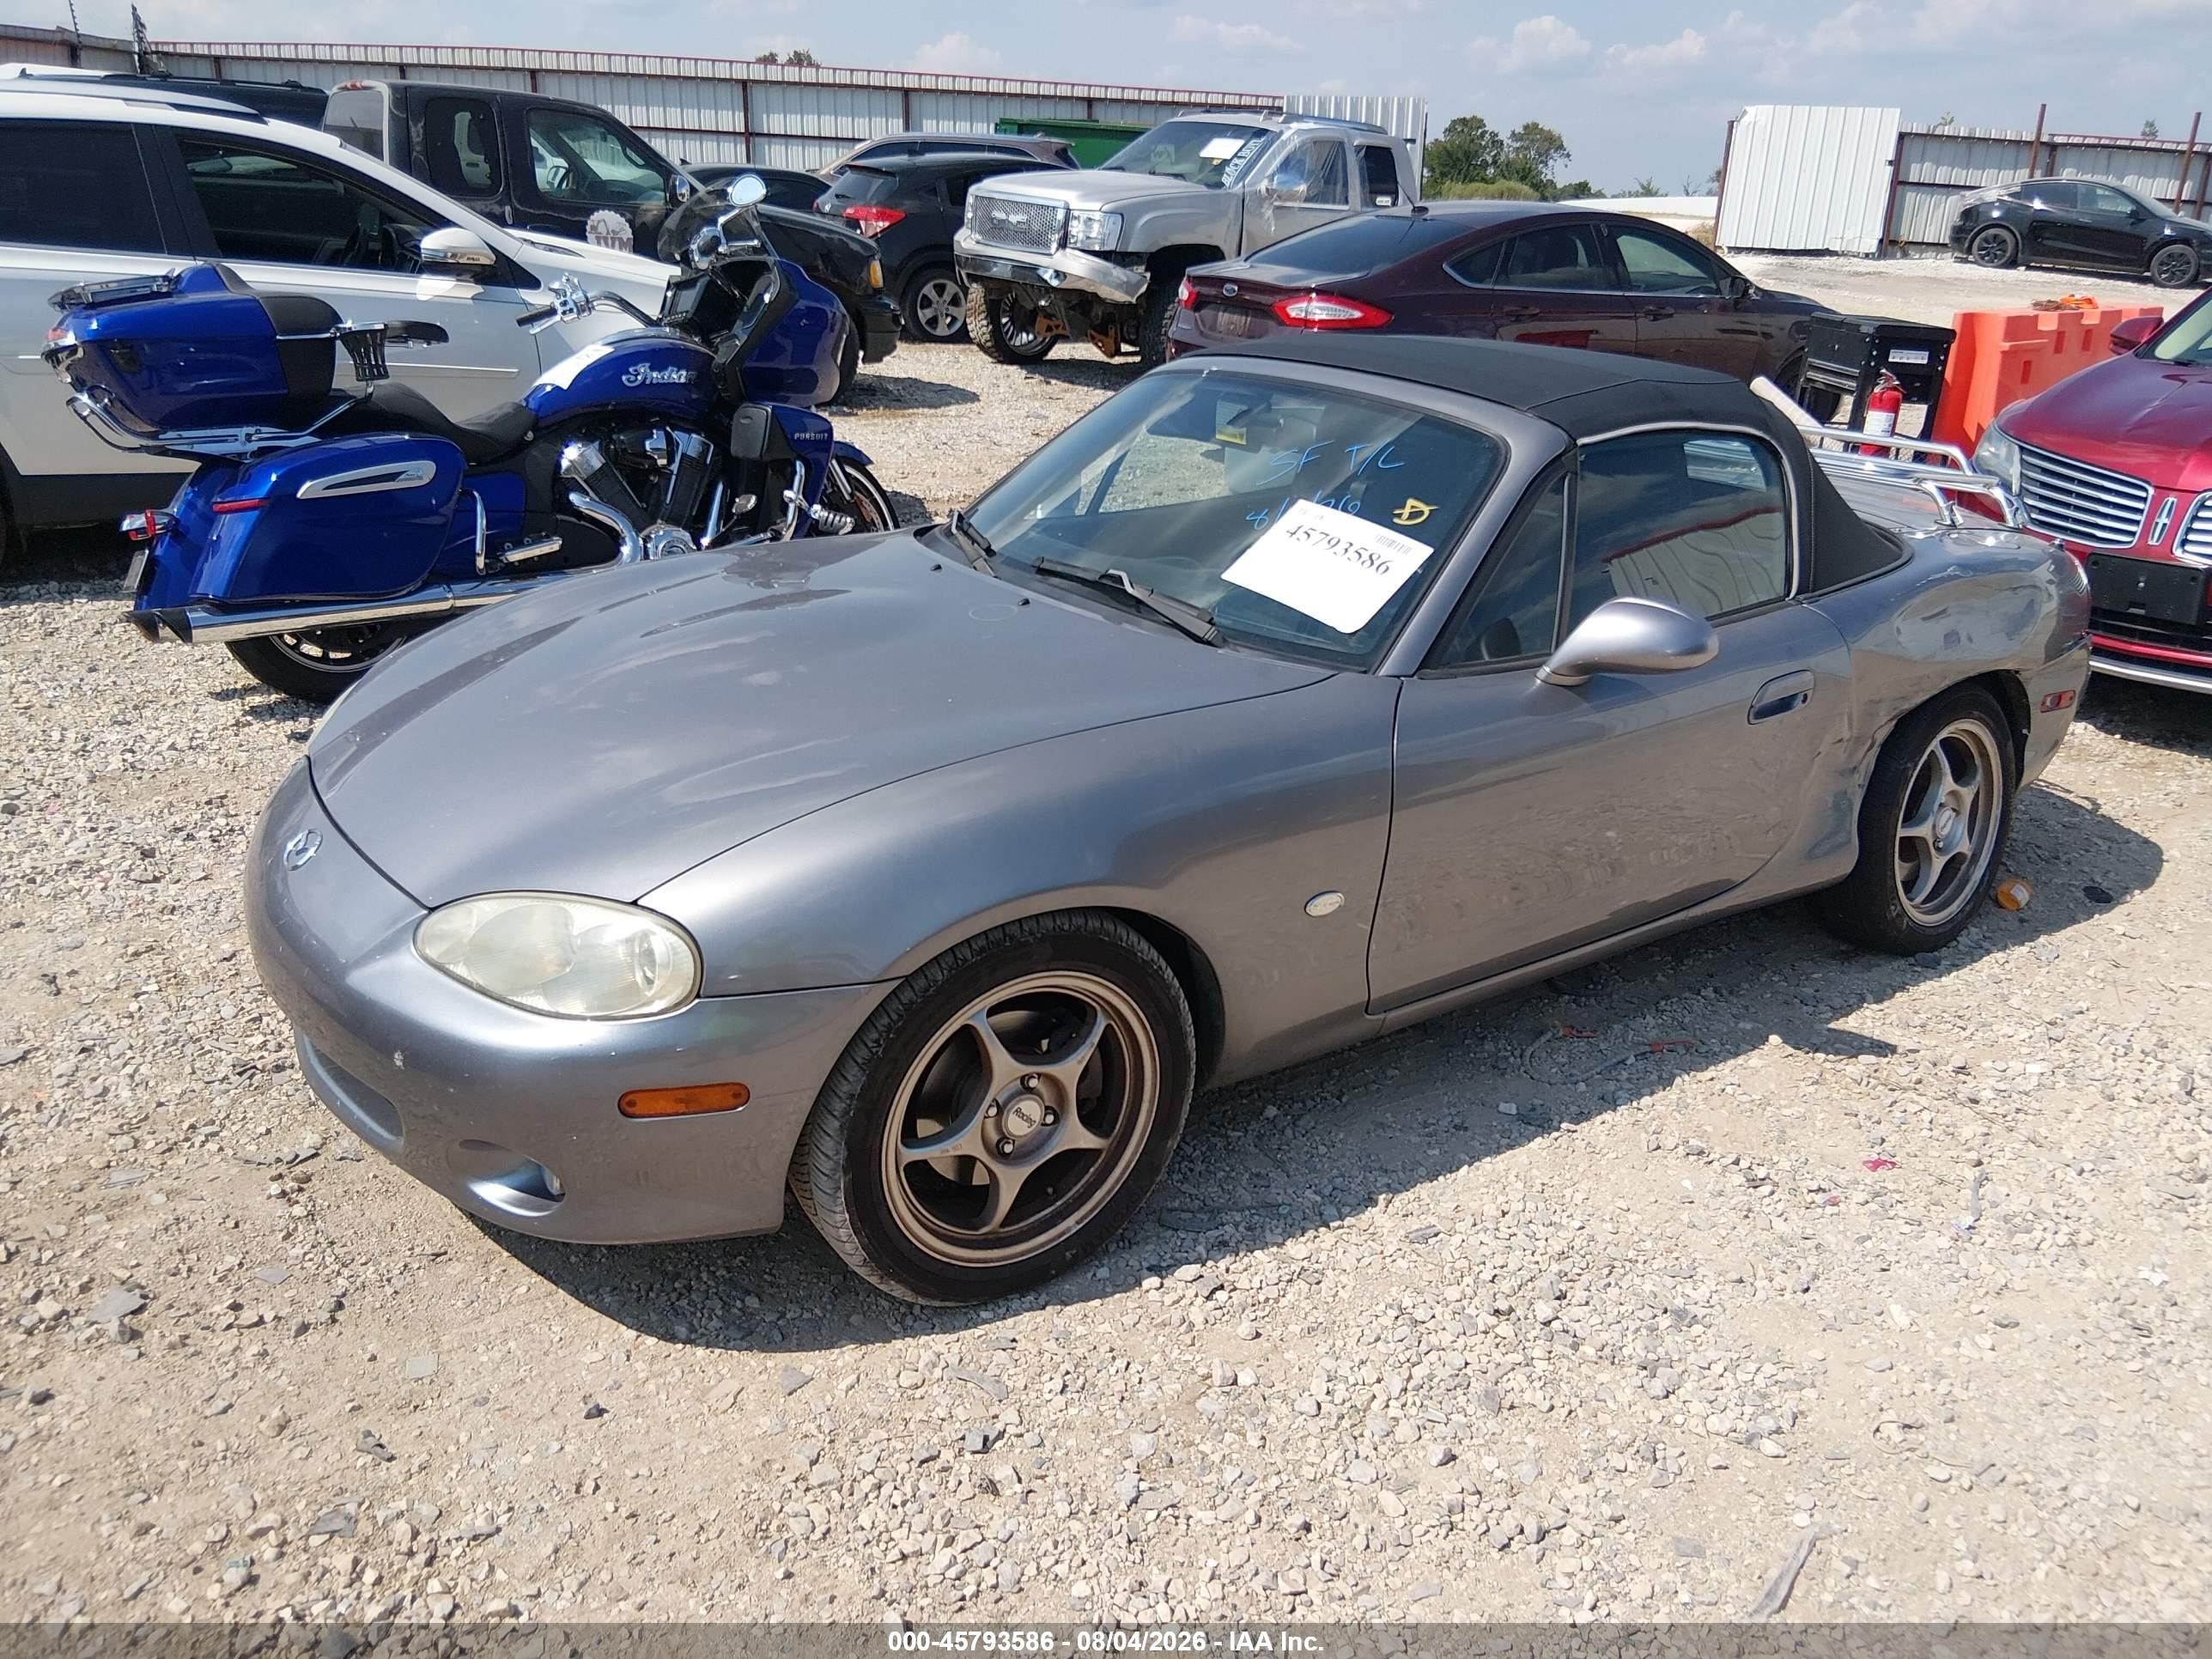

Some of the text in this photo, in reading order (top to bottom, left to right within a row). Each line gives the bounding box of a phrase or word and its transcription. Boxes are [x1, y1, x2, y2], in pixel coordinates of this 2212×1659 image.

[1221, 158, 1244, 187] BLOCK
[621, 362, 698, 387] Indian
[793, 432, 829, 441] PURSUIT
[1285, 525, 1395, 575] 45793586
